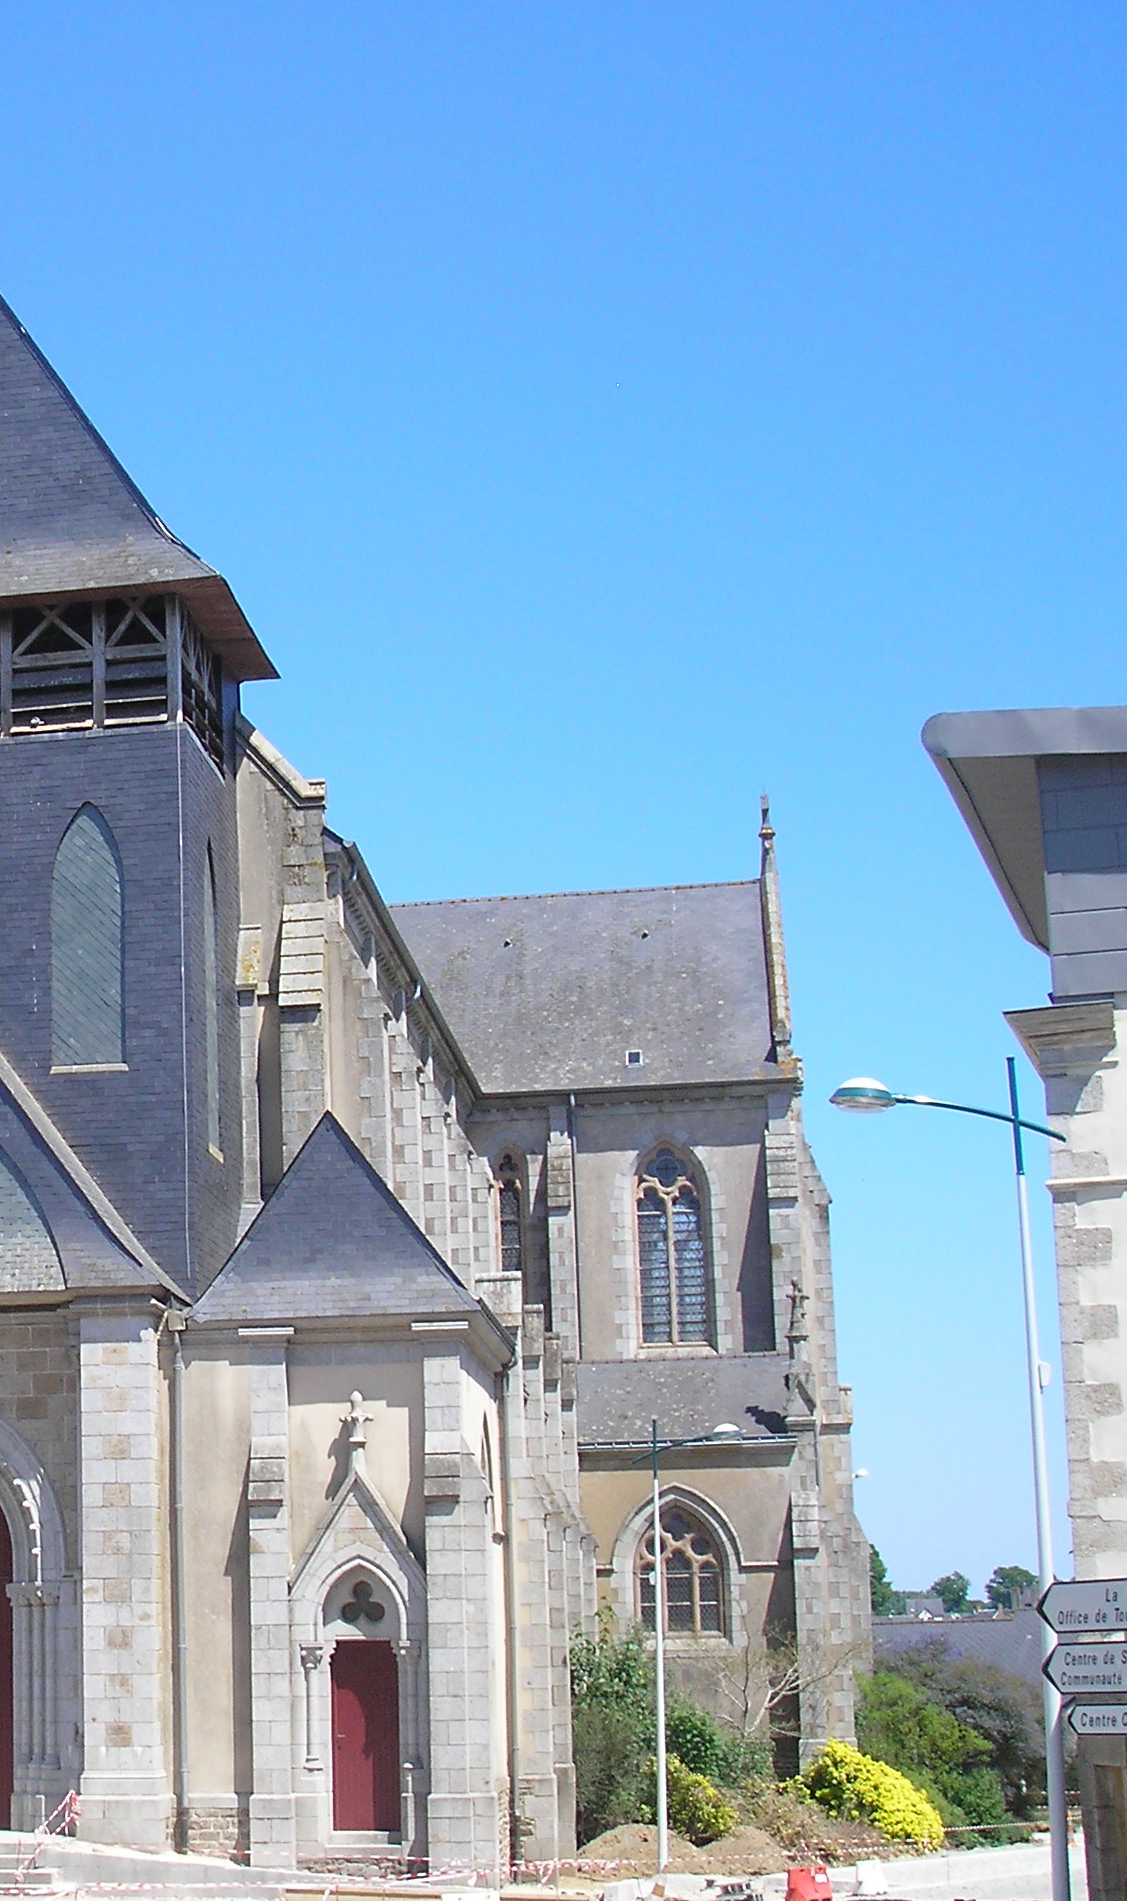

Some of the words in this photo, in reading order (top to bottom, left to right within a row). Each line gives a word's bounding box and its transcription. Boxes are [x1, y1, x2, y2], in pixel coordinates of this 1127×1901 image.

[1106, 1588, 1118, 1602] La
[1057, 1610, 1089, 1625] Office
[1095, 1608, 1107, 1623] de
[1064, 1651, 1097, 1666] Centre
[1103, 1650, 1115, 1665] de
[1060, 1671, 1122, 1685] Communauté
[1080, 1712, 1117, 1727] Centre
